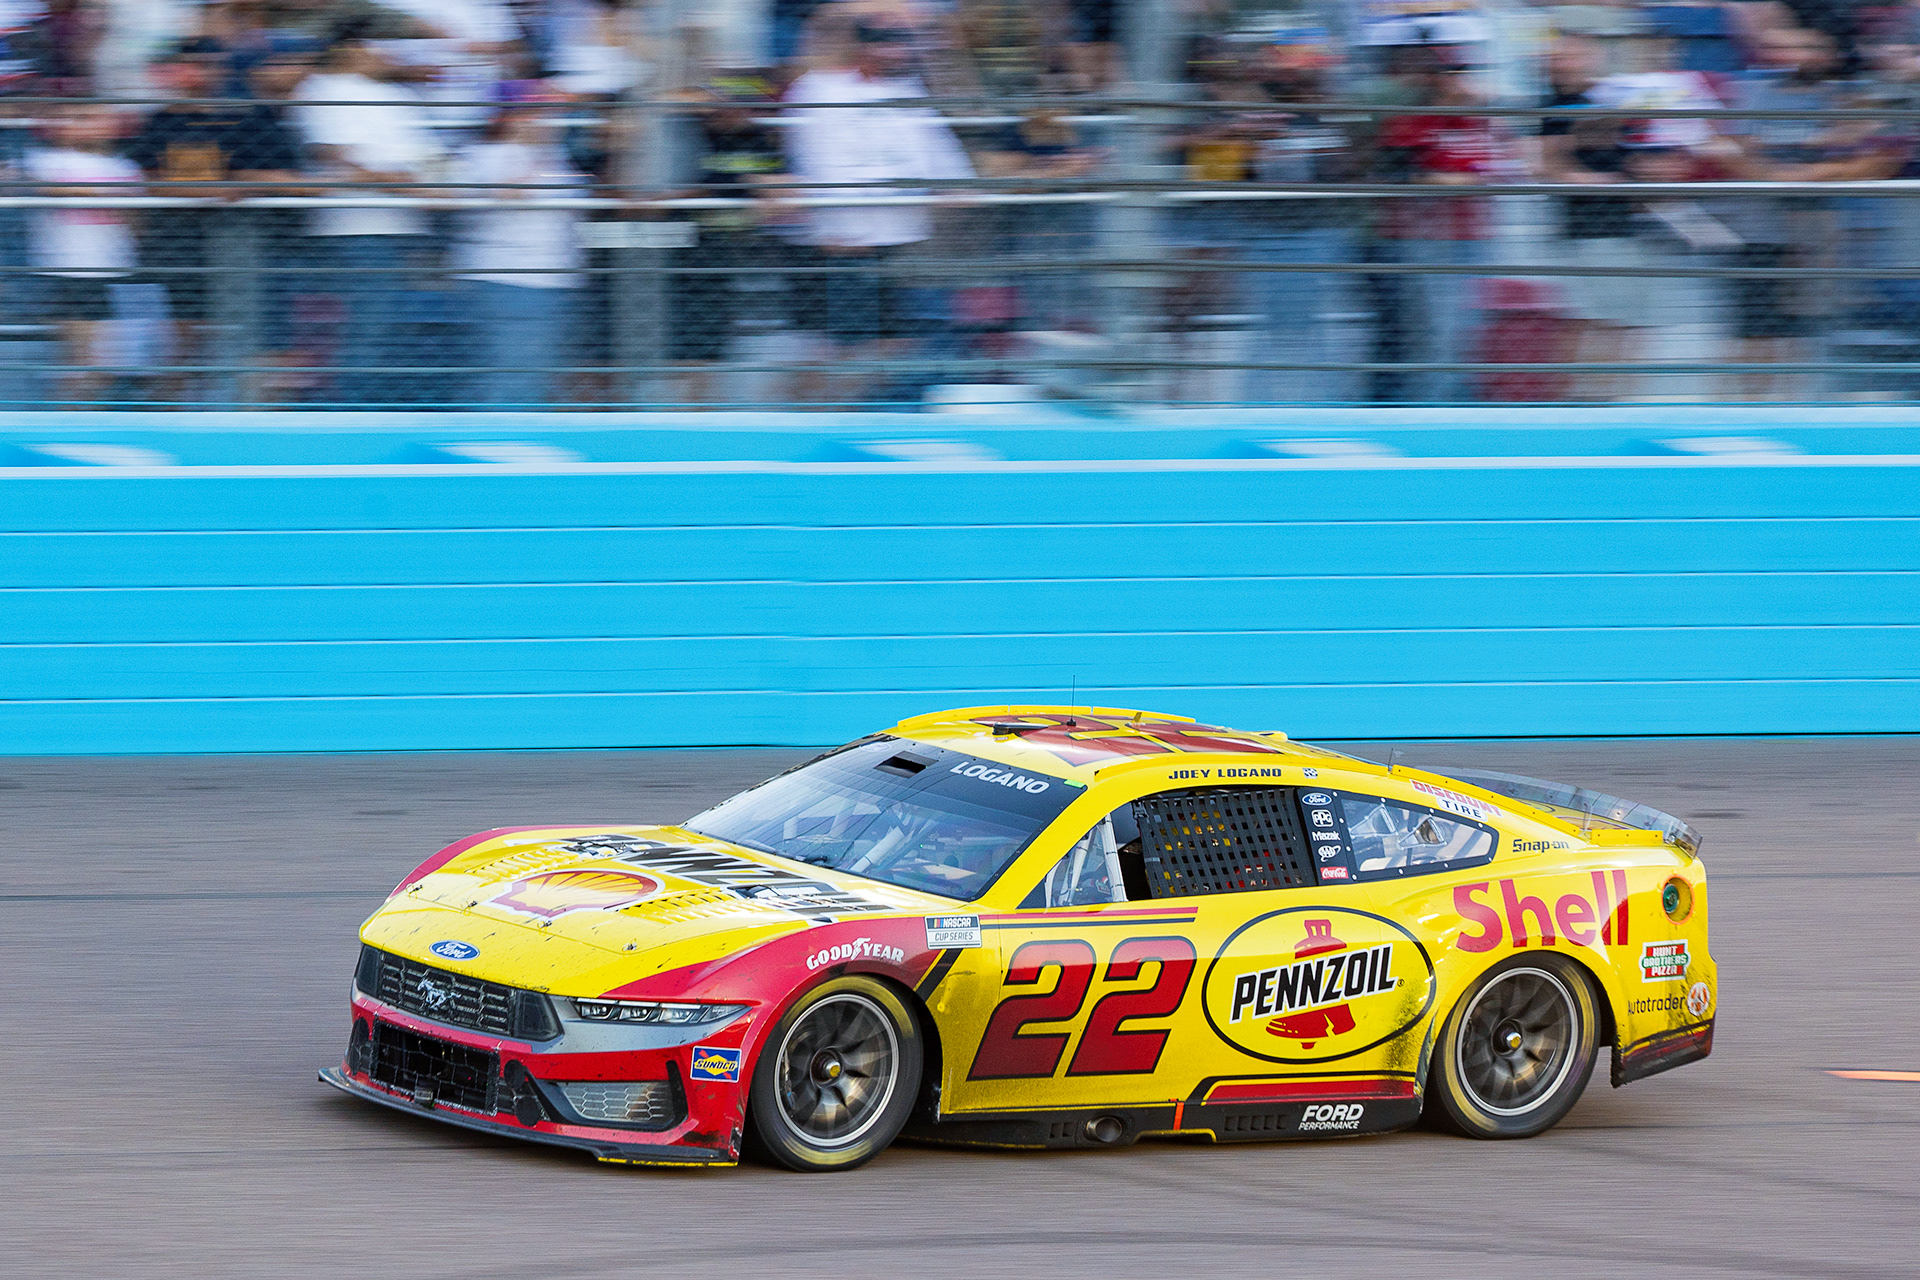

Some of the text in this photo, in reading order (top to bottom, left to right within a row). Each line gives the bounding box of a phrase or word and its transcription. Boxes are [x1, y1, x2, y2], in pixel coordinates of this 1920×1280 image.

[950, 761, 1050, 794] LOGANO
[1168, 768, 1282, 780] JOEY LOGANO
[1411, 780, 1502, 817] DISCOUNT
[1442, 799, 1482, 819] TIRE
[1314, 811, 1332, 826] PPG
[1311, 830, 1341, 842] Mazak
[1512, 839, 1570, 853] Snap-on
[1453, 869, 1629, 953] Shell
[942, 917, 972, 928] NASCAR
[934, 931, 974, 942] CUP SERIES
[806, 938, 904, 971] GOODYEAR
[1652, 946, 1678, 957] HUNT
[1643, 955, 1687, 968] BROTHERS
[1651, 965, 1678, 976] PIZZA
[1229, 943, 1399, 1024] PENNZOIL
[966, 935, 1198, 1082] 22
[696, 1060, 736, 1070] SUNOCO
[1301, 1103, 1364, 1122] FORD
[1298, 1120, 1360, 1131] PERFORMANCE
